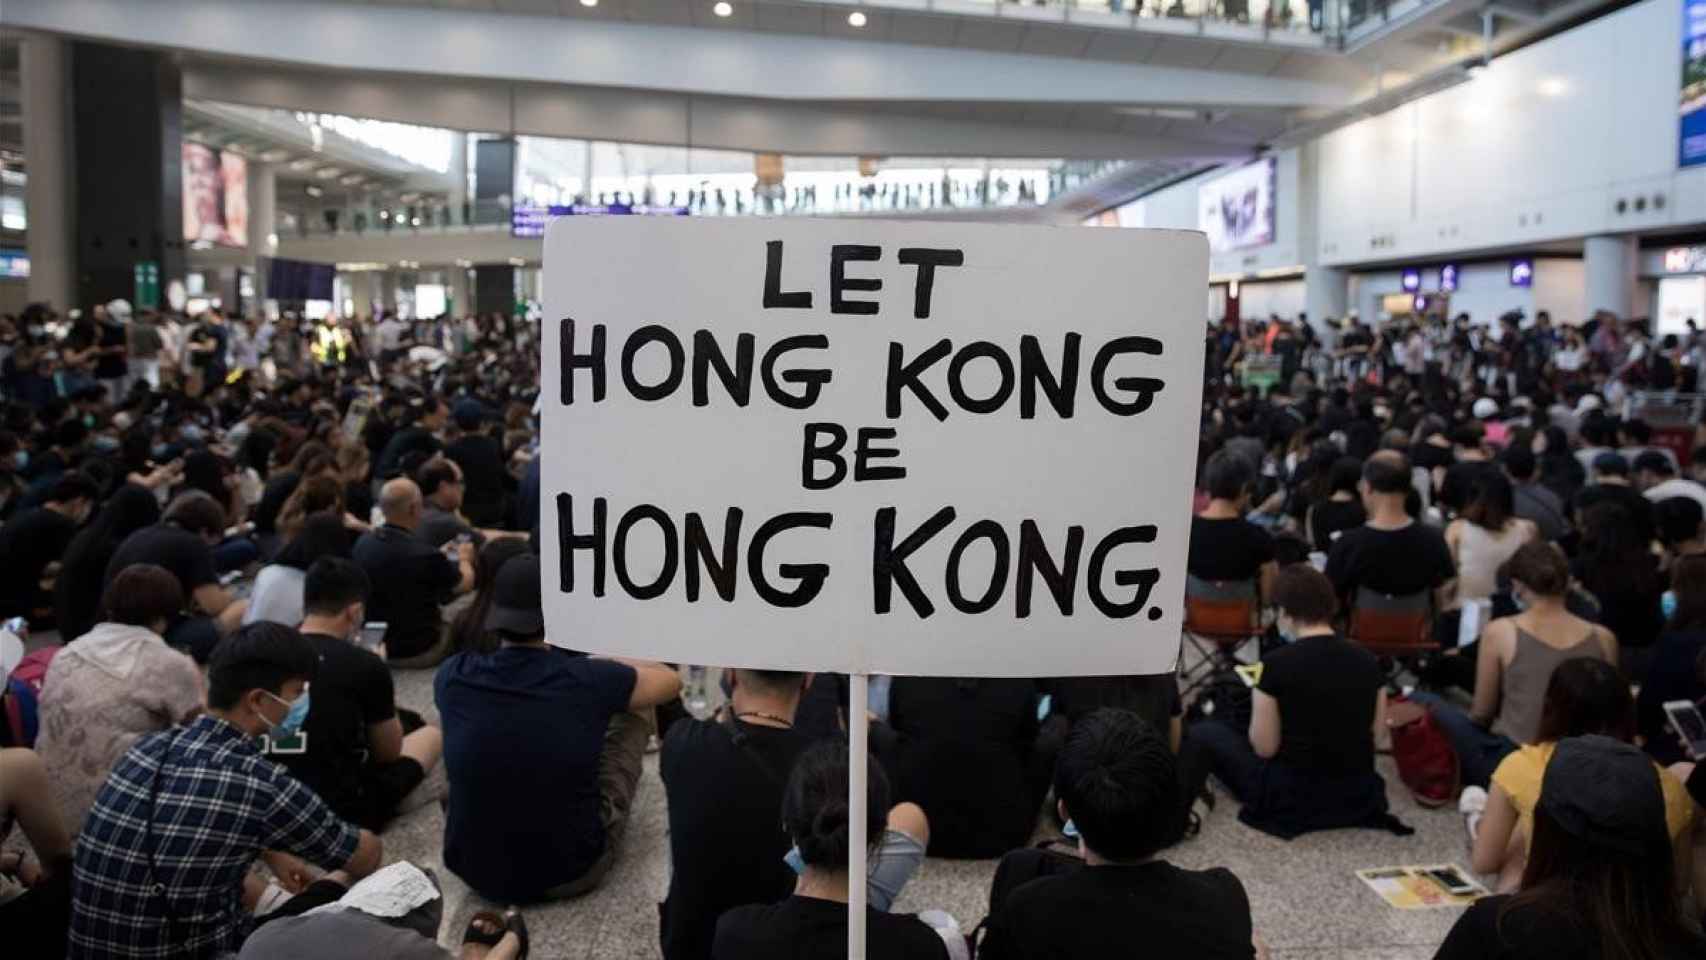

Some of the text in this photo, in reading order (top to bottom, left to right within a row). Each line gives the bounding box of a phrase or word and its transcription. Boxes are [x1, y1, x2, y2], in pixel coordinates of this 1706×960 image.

[762, 241, 965, 320] LET
[559, 317, 1166, 423] HONG KONG
[801, 422, 907, 491] BE
[556, 491, 1163, 622] HONG KONG.
